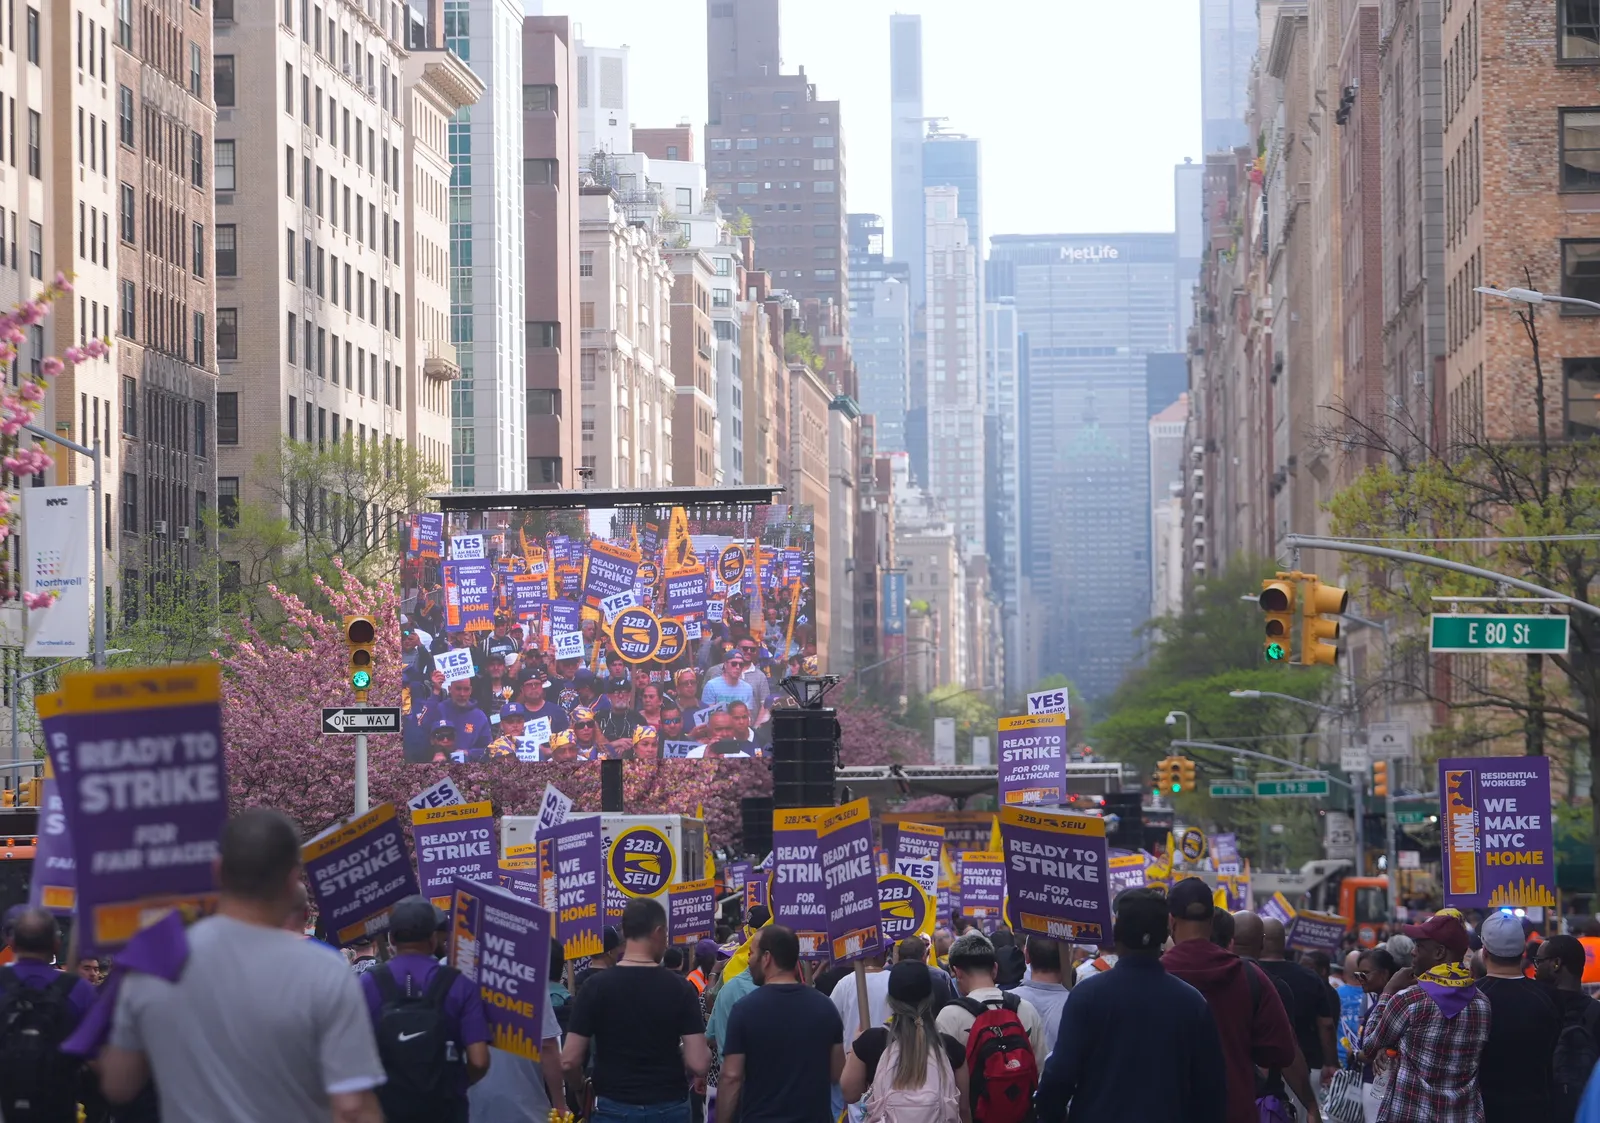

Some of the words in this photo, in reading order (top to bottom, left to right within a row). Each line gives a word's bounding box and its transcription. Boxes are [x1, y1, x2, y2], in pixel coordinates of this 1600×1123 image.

[1060, 246, 1118, 259] MetLife
[47, 498, 68, 506] NYC
[454, 538, 480, 549] YES
[724, 551, 740, 560] 32BJ
[592, 558, 620, 571] READY
[622, 566, 633, 575] TO
[36, 577, 82, 587] Northwell
[591, 565, 631, 585] STRIKE
[595, 580, 608, 588] FOR
[669, 581, 693, 589] READY
[670, 586, 703, 598] STRIKE
[604, 594, 631, 611] YES
[622, 616, 652, 629] 32BJ
[1469, 623, 1478, 643] E
[1485, 623, 1506, 644] 80
[1513, 624, 1530, 644] St
[555, 635, 580, 647] YES
[620, 642, 650, 653] SEIU
[437, 652, 468, 669] YES
[1030, 692, 1064, 709] YES
[334, 716, 355, 725] ONE
[367, 716, 389, 725] WAY
[1003, 737, 1041, 748] READY
[1044, 736, 1060, 744] TO
[77, 736, 176, 769] READY
[180, 732, 218, 762] TO
[1003, 746, 1060, 762] STRIKE
[1004, 772, 1059, 782] HEALTHCARE
[79, 763, 220, 813] STRIKE
[1023, 791, 1040, 801] HOME
[1484, 799, 1517, 812] WE
[426, 811, 445, 819] 32BJ
[784, 816, 800, 824] 32BJ
[824, 817, 835, 828] 32BJ
[843, 808, 858, 820] SEIU
[1018, 814, 1041, 824] 32BJ
[1061, 821, 1086, 830] SEIU
[1485, 816, 1541, 830] MAKE
[420, 831, 467, 846] READY
[470, 829, 489, 839] TO
[558, 832, 594, 845] RESIDENTIAL
[1331, 830, 1351, 843] 25
[1454, 812, 1474, 852] HOME
[558, 840, 587, 851] WORKERS
[624, 839, 662, 852] 32BJ
[900, 837, 926, 846] READY
[1486, 834, 1525, 848] NYC
[315, 844, 371, 881] READY
[373, 832, 396, 851] TO
[423, 841, 491, 862] STRIKE
[777, 846, 817, 860] READY
[823, 843, 851, 867] READY
[852, 837, 868, 854] TO
[899, 844, 938, 856] STRIKE
[1010, 840, 1069, 859] READY
[1073, 849, 1098, 863] TO
[1486, 851, 1543, 865] HOME
[320, 844, 401, 896] STRIKE
[436, 867, 457, 876] FOR
[460, 864, 480, 873] OUR
[559, 858, 580, 874] WE
[824, 855, 871, 890] STRIKE
[898, 863, 934, 878] YES
[1011, 855, 1099, 883] STRIKE
[559, 871, 595, 890] MAKE
[623, 873, 660, 886] SEIU
[964, 876, 1001, 886] STRIKE
[333, 901, 361, 918] FAIR
[363, 875, 406, 905] WAGES
[355, 881, 379, 898] FOR
[1043, 884, 1069, 896] FOR
[559, 890, 585, 906] NYC
[673, 896, 699, 906] READY
[700, 895, 712, 903] TO
[796, 893, 815, 903] FOR
[840, 891, 855, 905] FOR
[1019, 889, 1047, 902] FAIR
[1051, 895, 1098, 909] WAGES
[560, 903, 597, 923] HOME
[673, 903, 712, 916] STRIKE
[780, 905, 799, 915] FAIR
[831, 907, 843, 922] FAIR
[845, 900, 873, 915] WAGES
[484, 905, 539, 930] RESIDENTIAL
[484, 912, 527, 934] WORKERS
[689, 919, 710, 928] WAGES
[1047, 920, 1073, 937] HOME
[1296, 926, 1340, 939] STRIKE
[484, 932, 515, 957] WE
[483, 950, 535, 982] MAKE
[481, 968, 518, 994] NYC
[480, 987, 534, 1018] HOME
